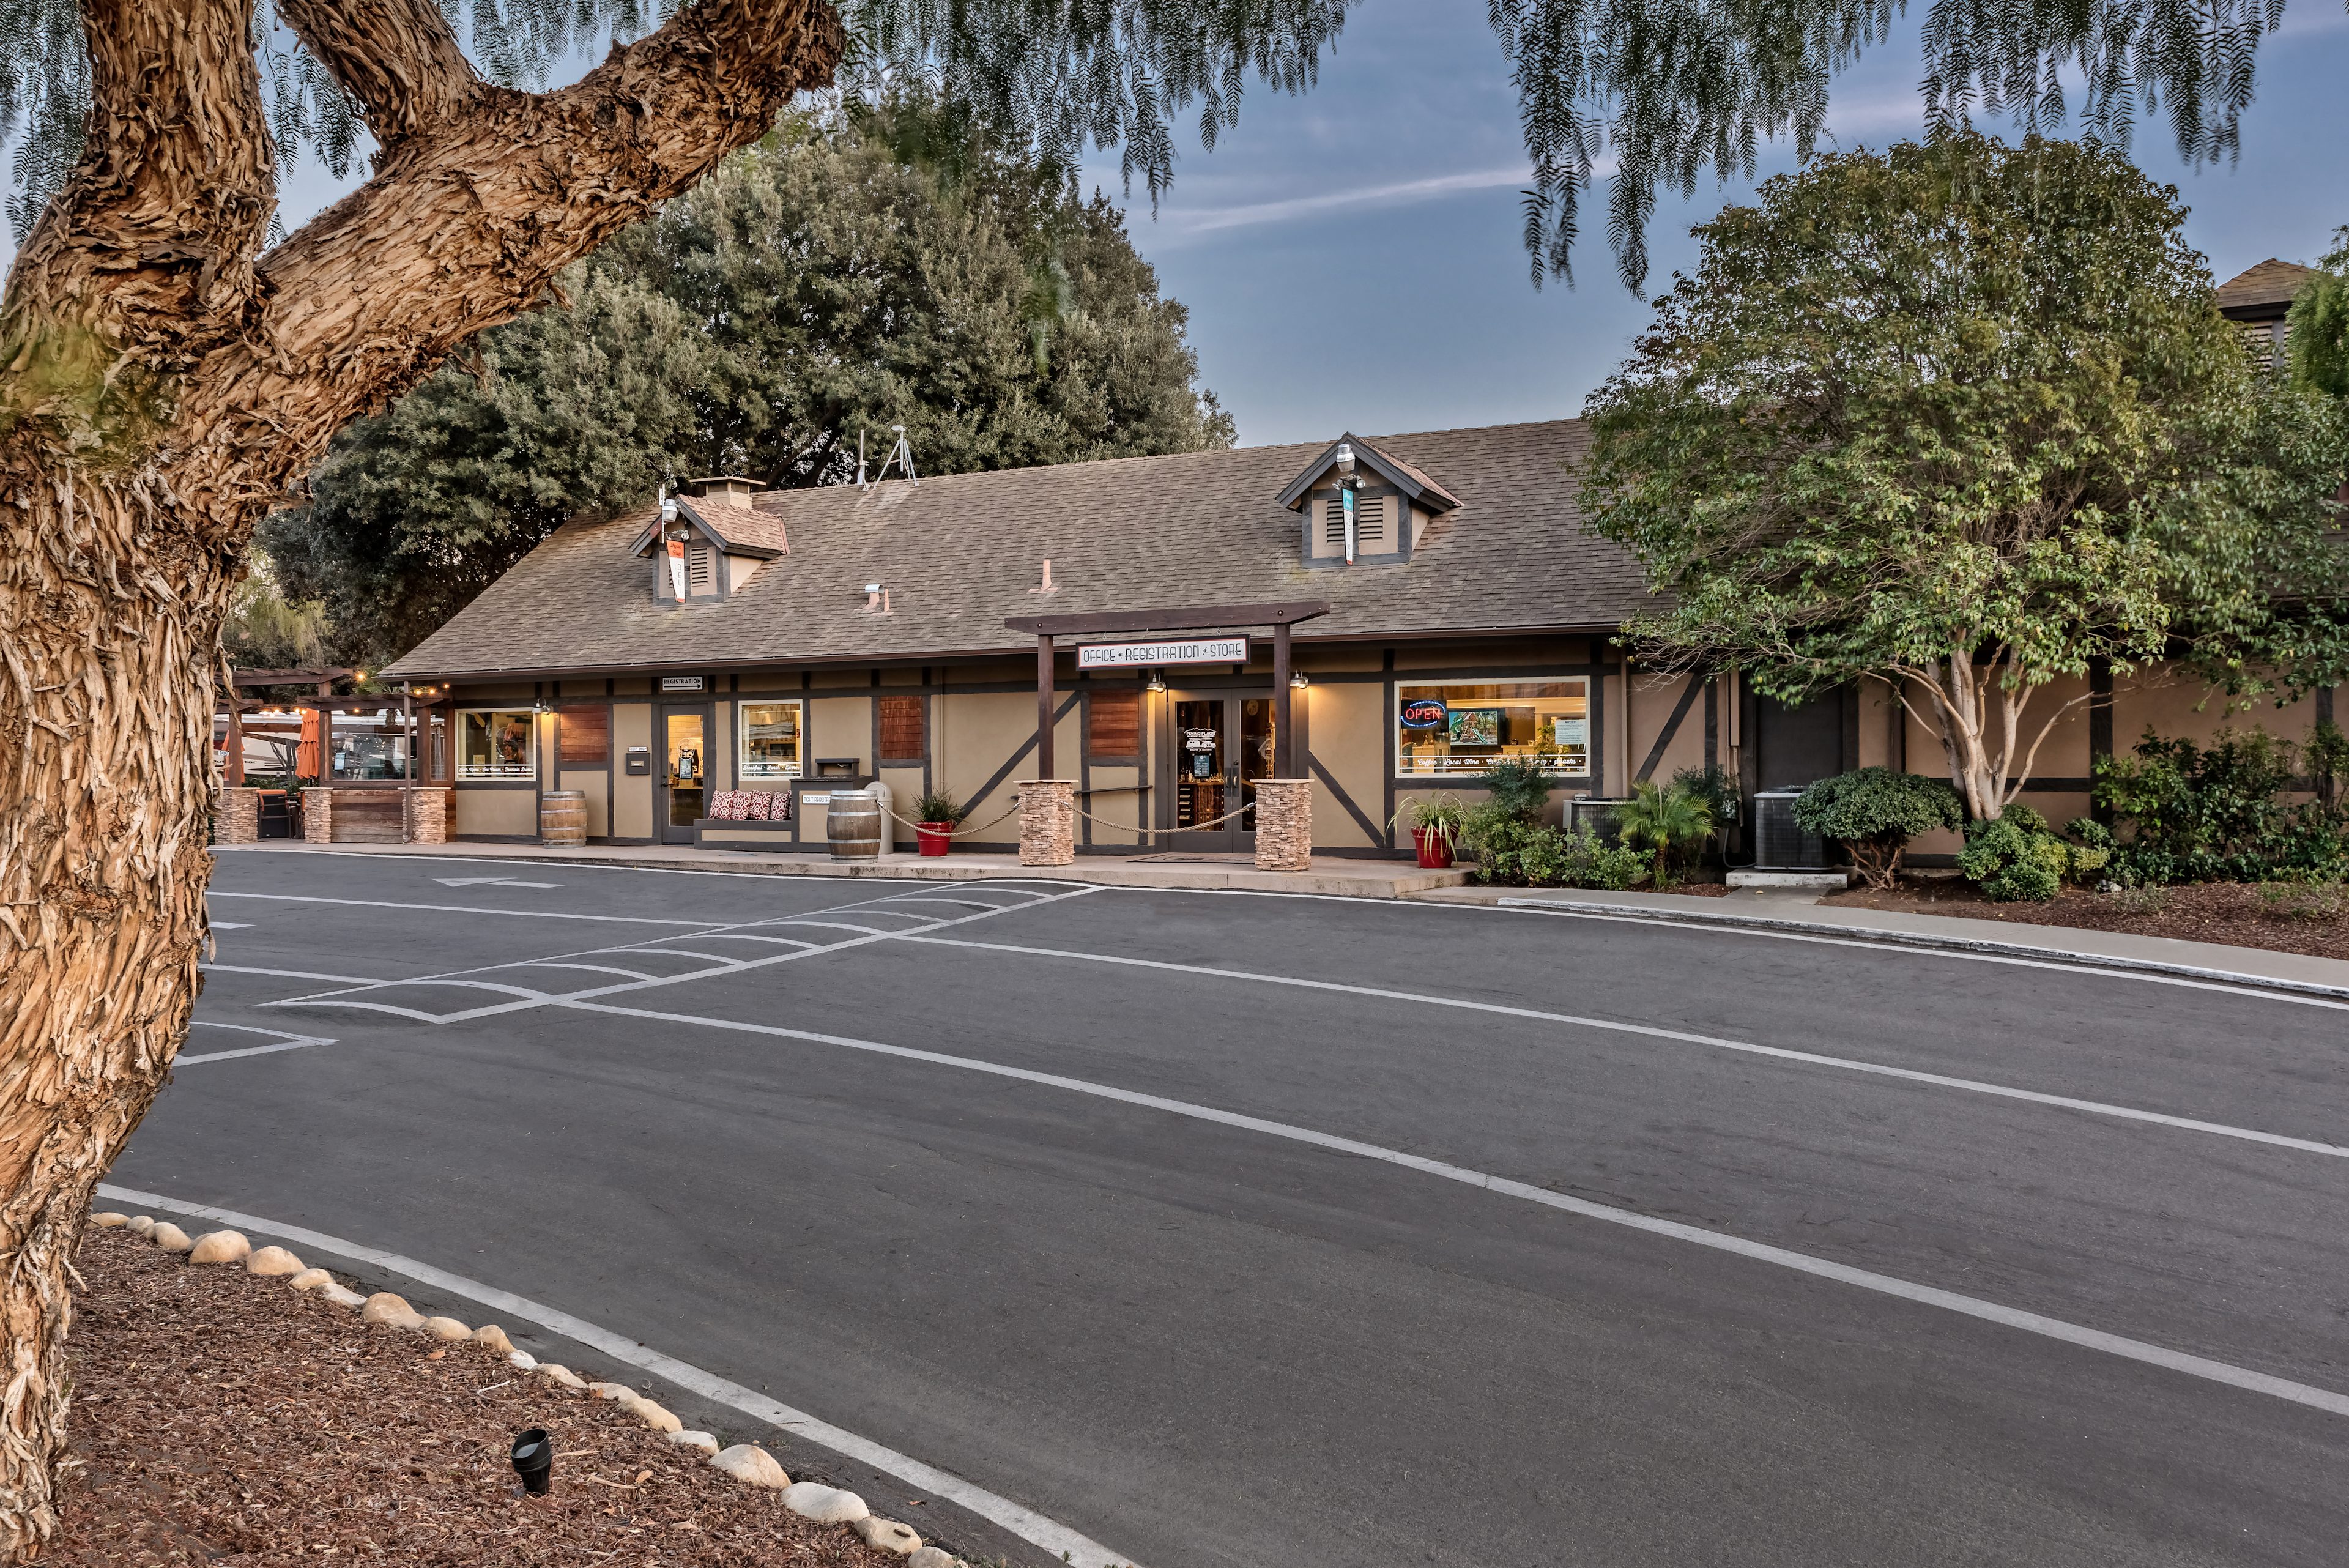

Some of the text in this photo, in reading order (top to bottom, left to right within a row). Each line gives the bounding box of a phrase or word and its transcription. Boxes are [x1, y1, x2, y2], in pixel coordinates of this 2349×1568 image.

[1083, 643, 1242, 663] OFFICE REGISTRATION STORE
[1406, 708, 1441, 720] OPEN
[1417, 758, 1438, 767] Coffee
